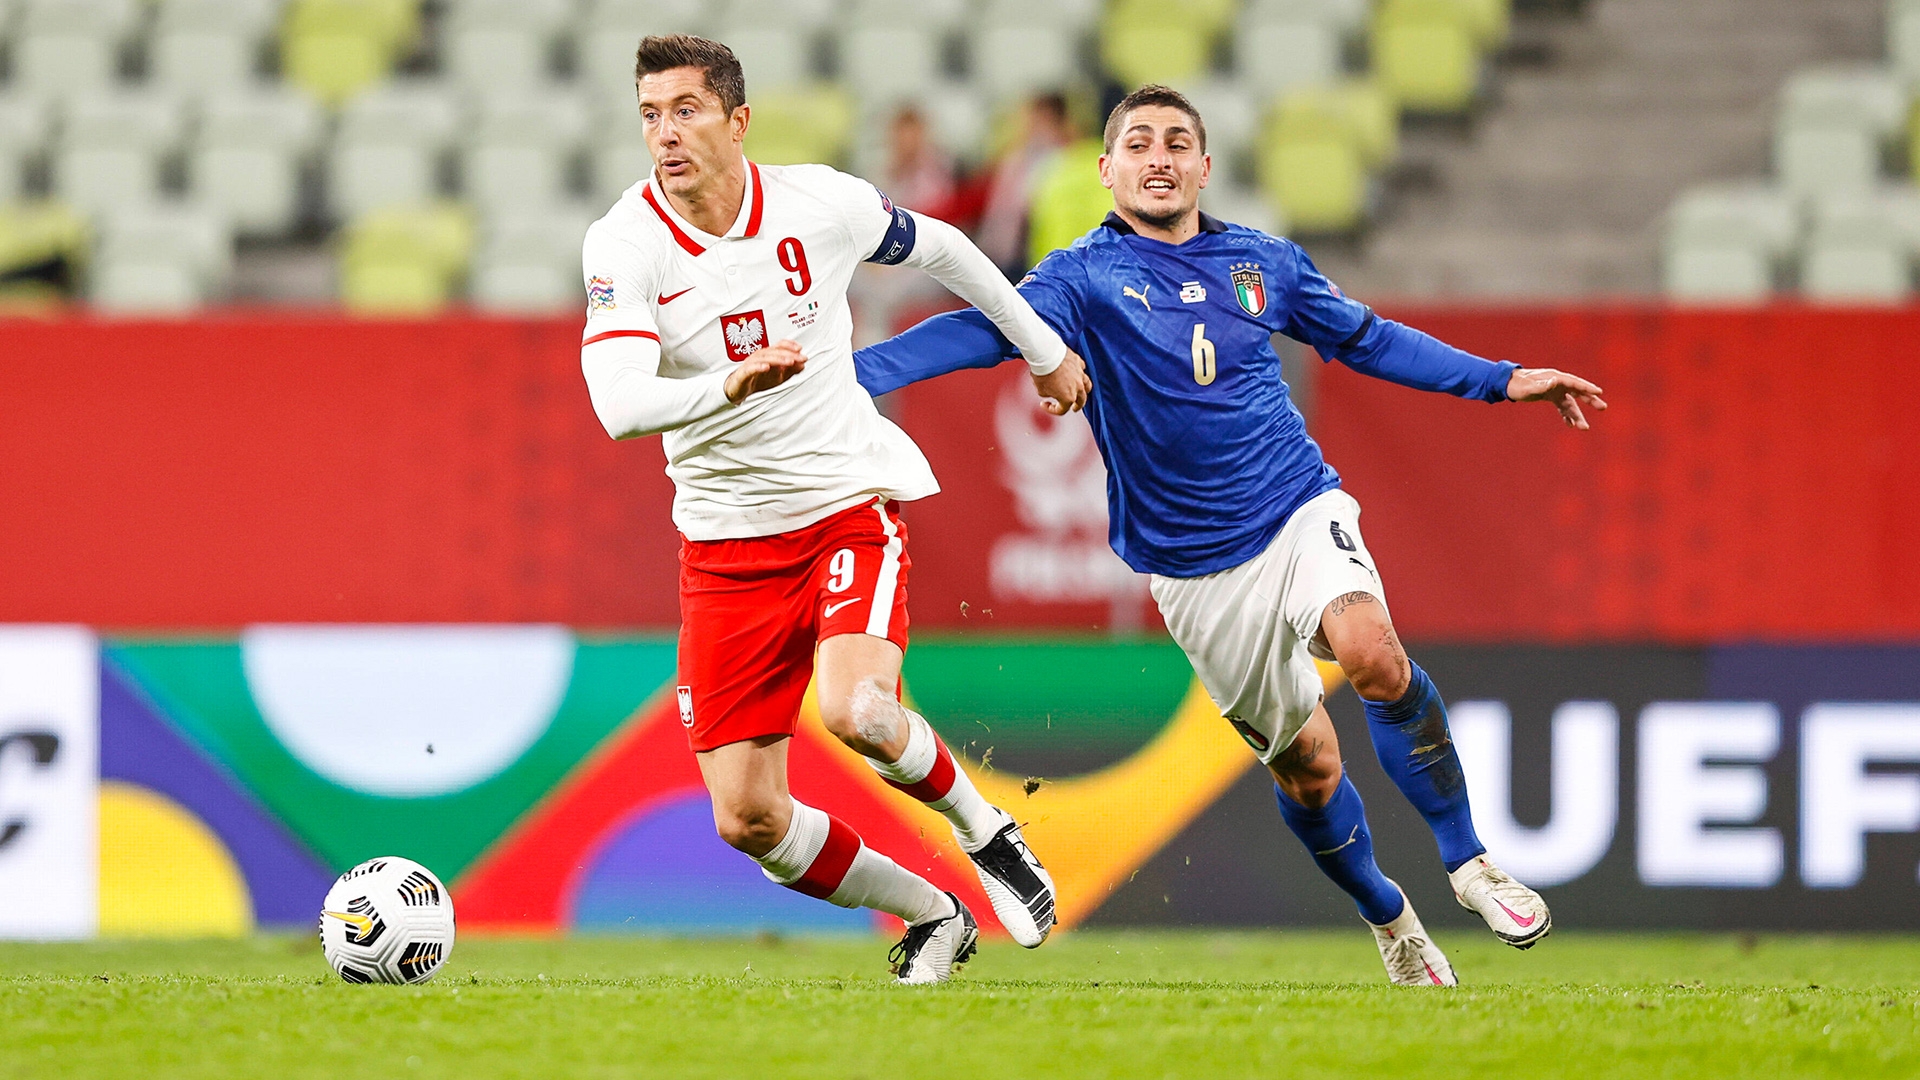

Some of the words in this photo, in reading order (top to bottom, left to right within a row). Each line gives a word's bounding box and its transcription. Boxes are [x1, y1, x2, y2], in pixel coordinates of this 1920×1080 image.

[776, 236, 812, 297] 9
[1234, 273, 1260, 282] ITALIA
[1191, 323, 1217, 387] 6
[1329, 520, 1357, 552] 6
[827, 548, 856, 593] 9
[1446, 699, 1920, 889] UEF
